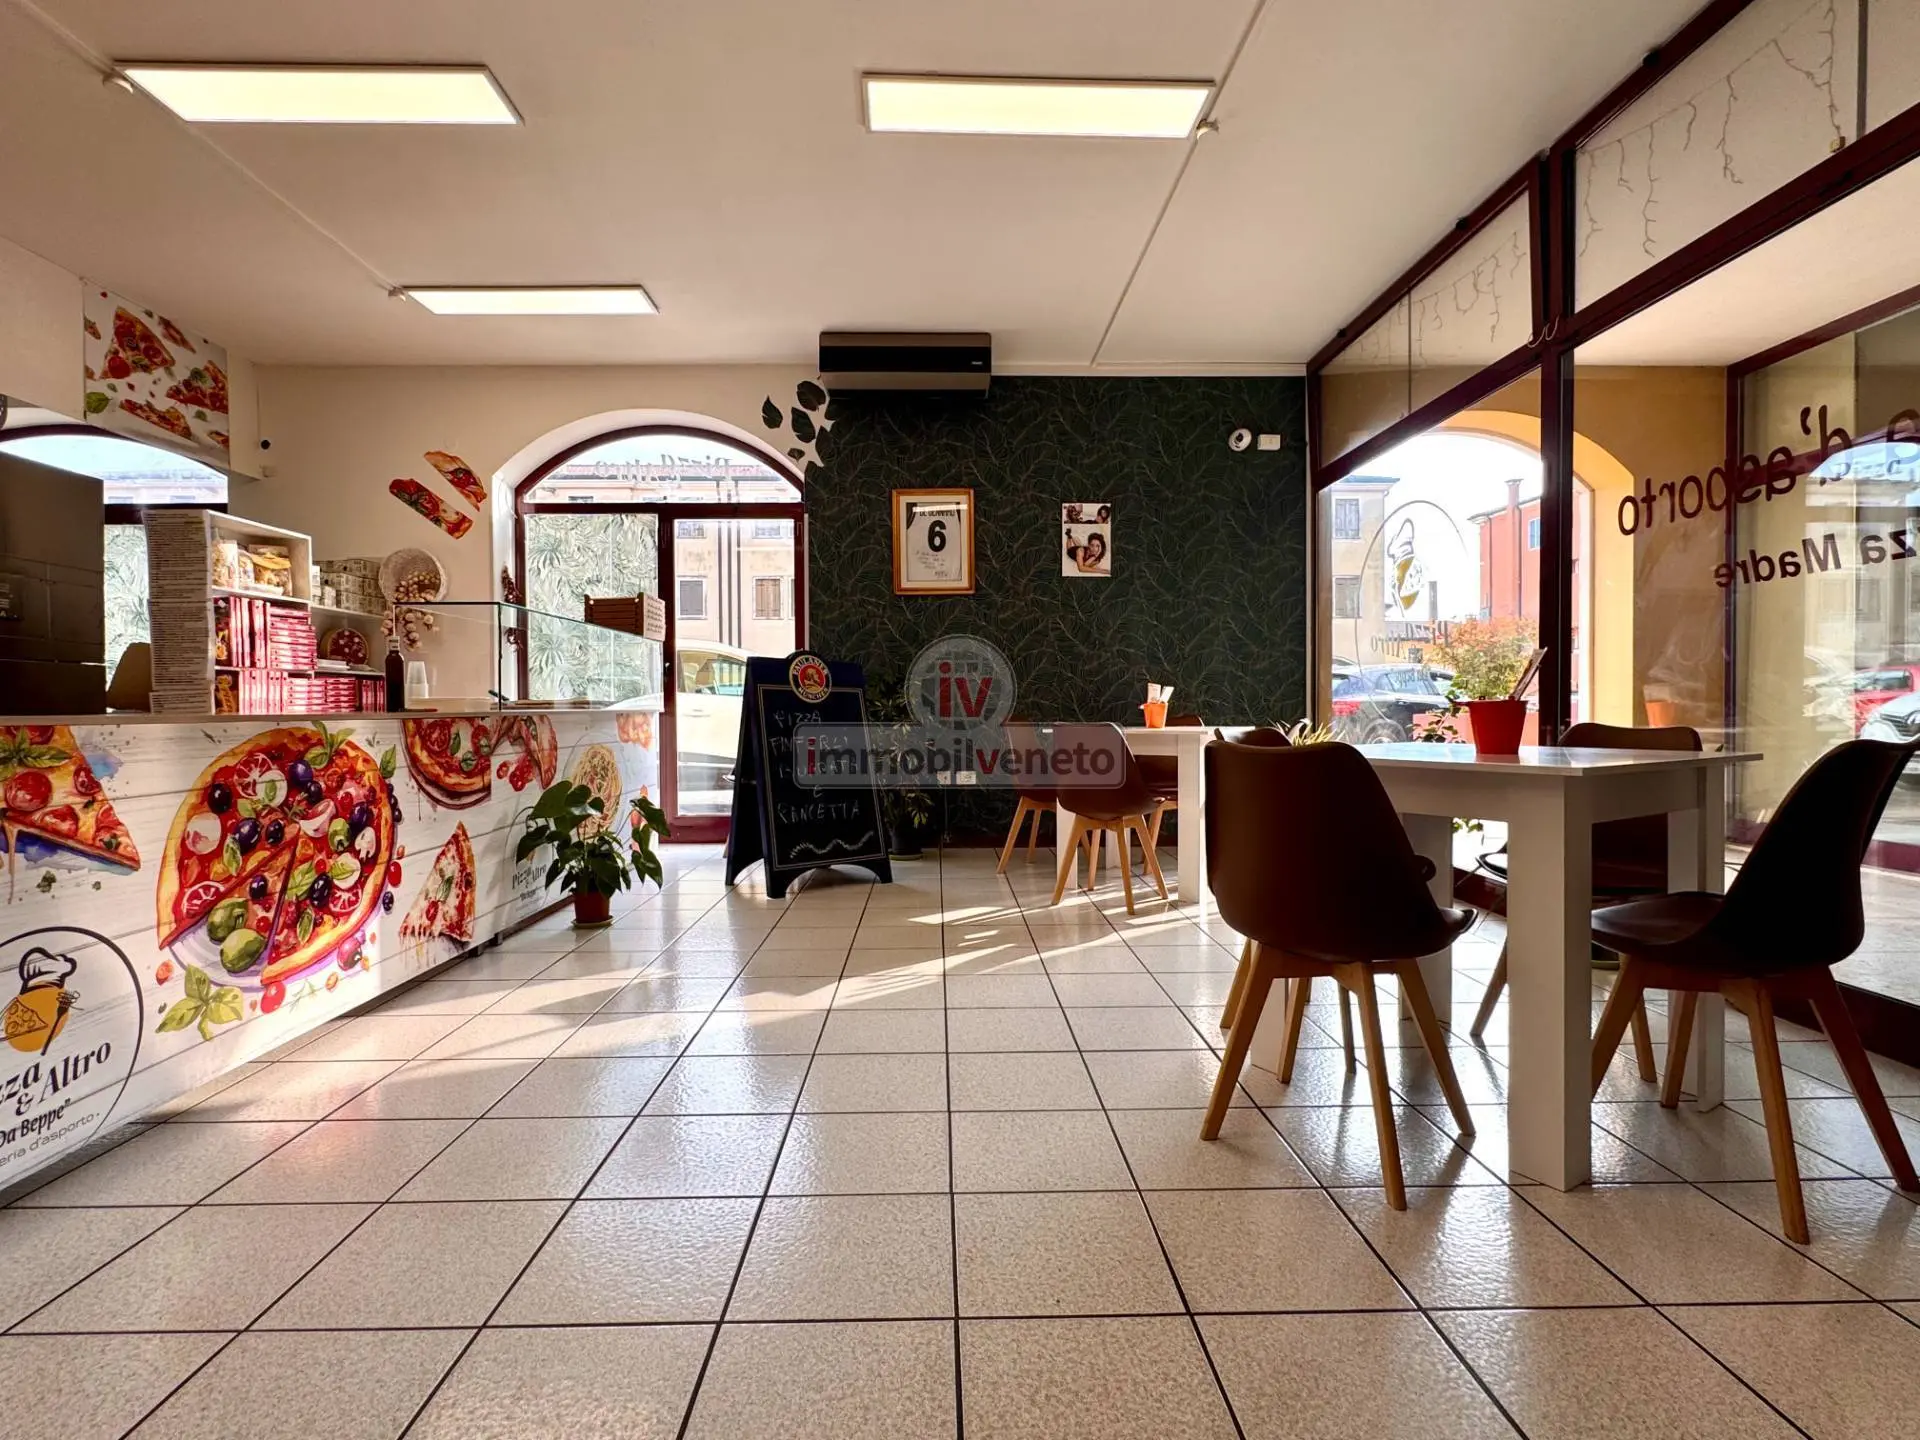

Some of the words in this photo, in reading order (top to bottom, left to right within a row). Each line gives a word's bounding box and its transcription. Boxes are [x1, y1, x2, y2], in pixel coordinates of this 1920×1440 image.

[928, 519, 947, 553] 6
[15, 1093, 35, 1116] &
[38, 1042, 111, 1104] Altro
